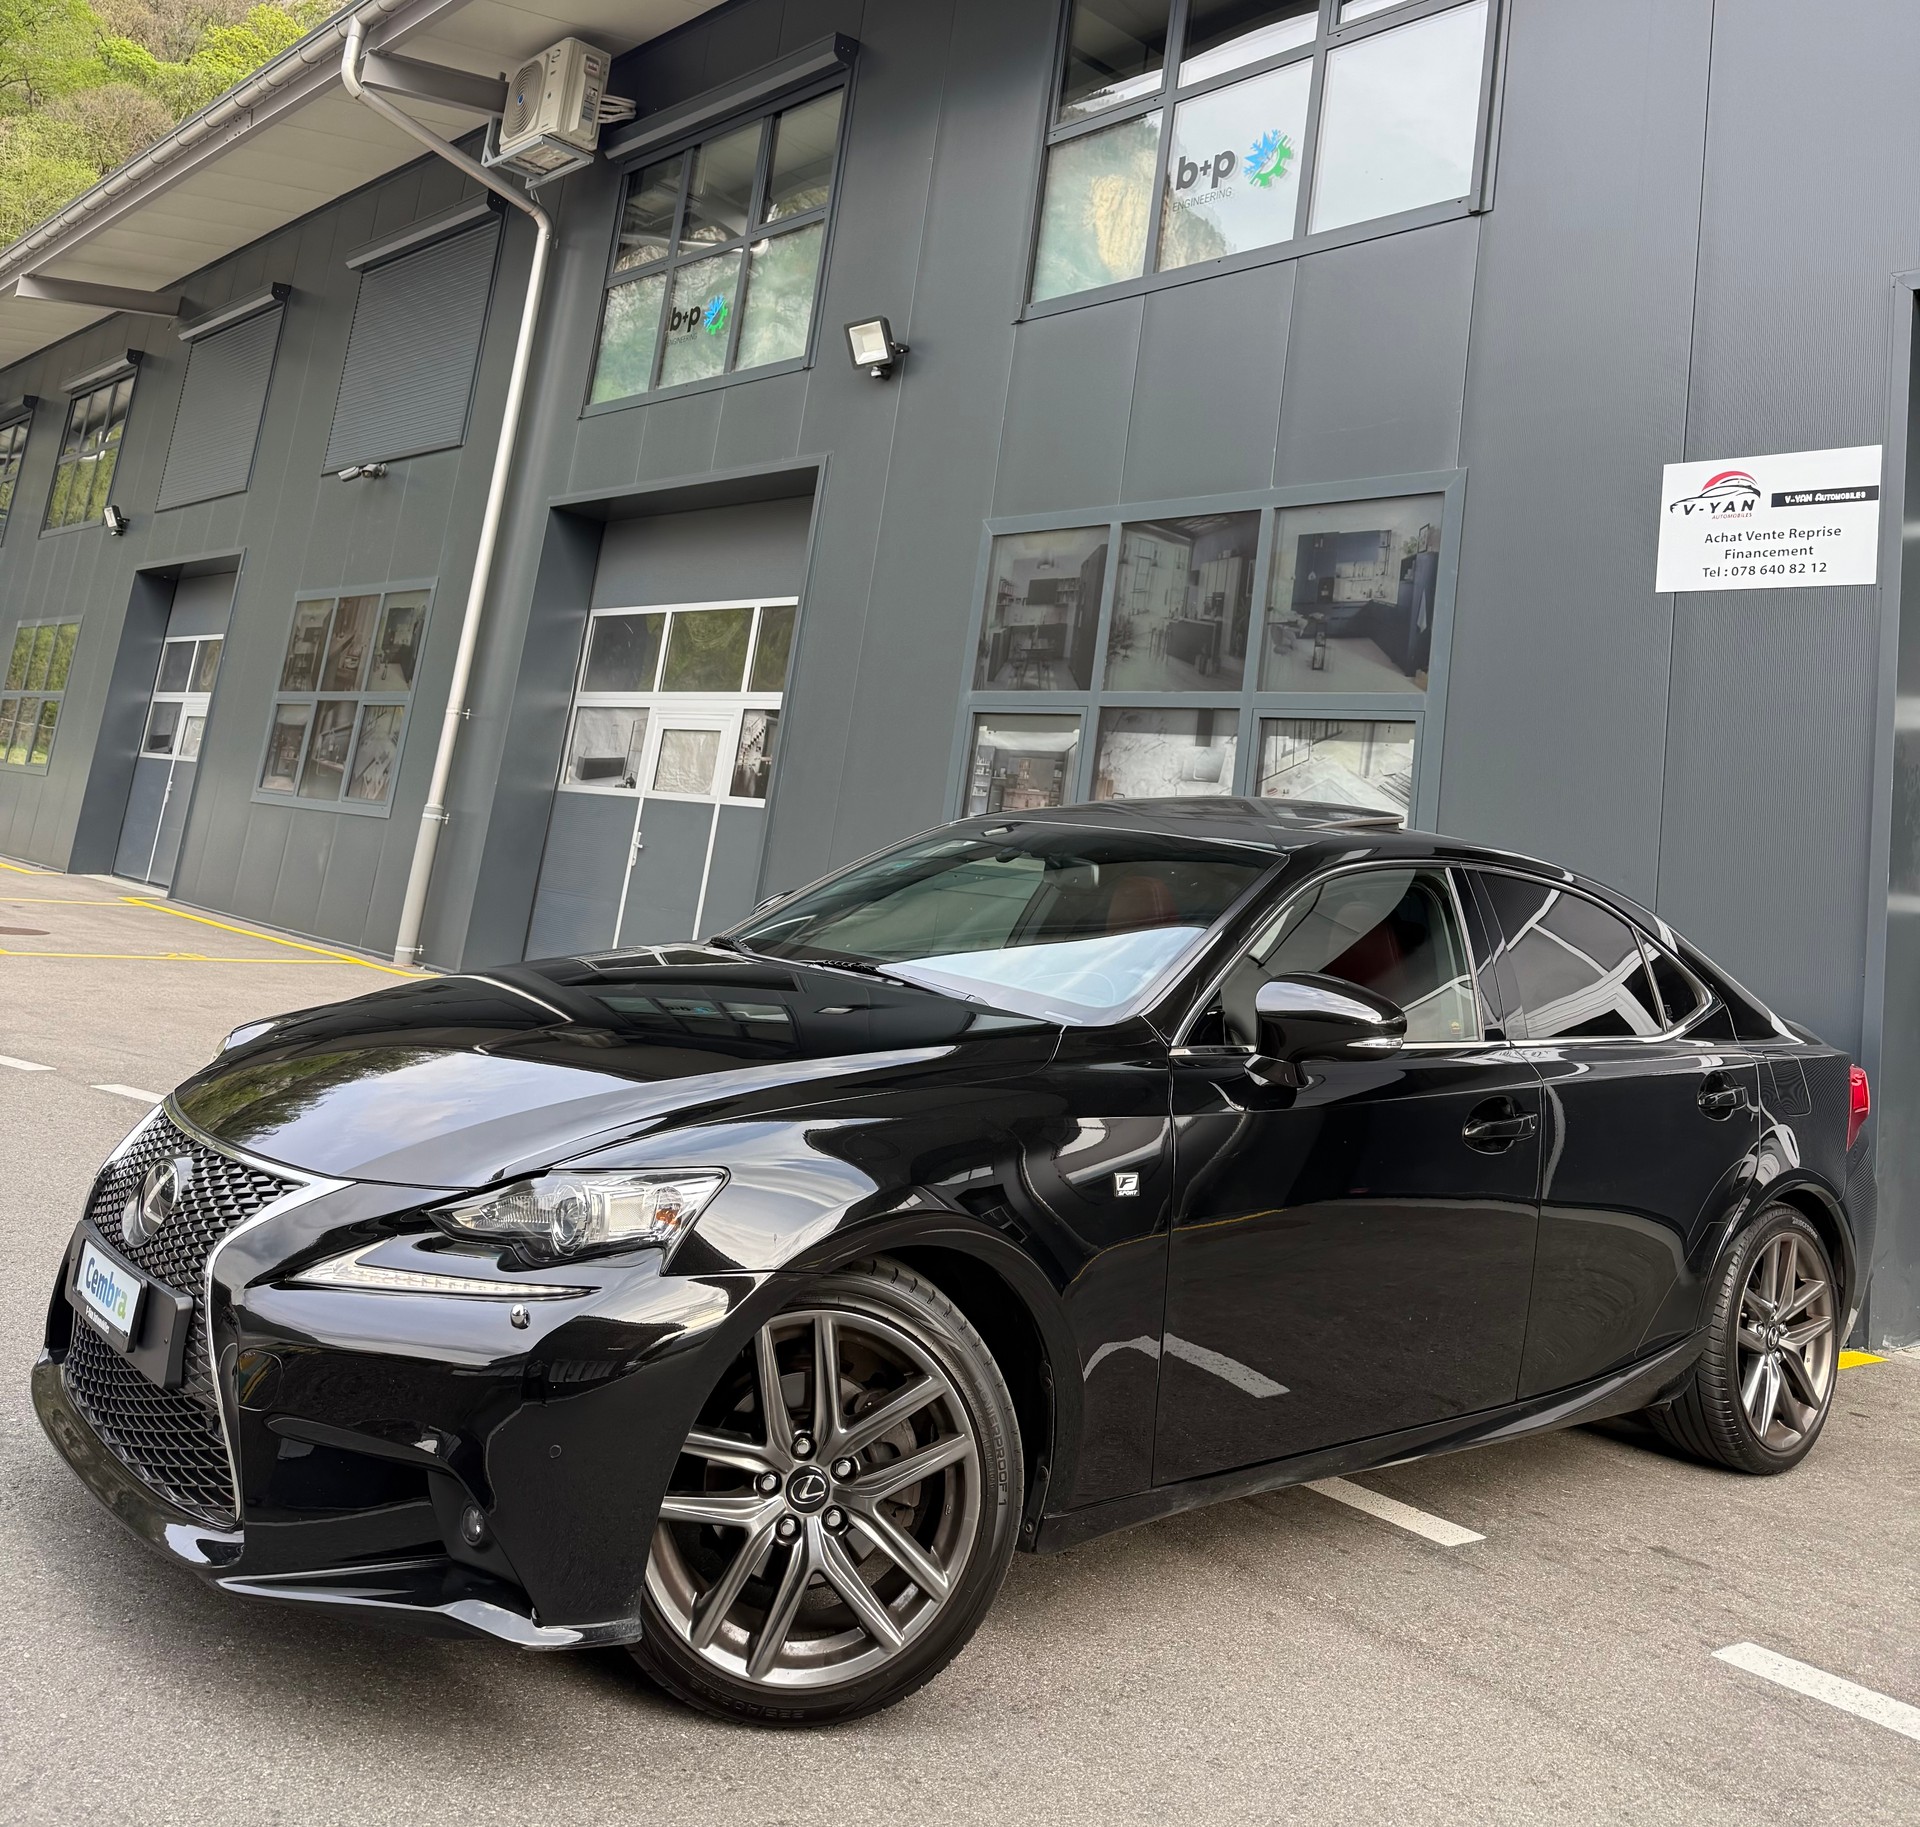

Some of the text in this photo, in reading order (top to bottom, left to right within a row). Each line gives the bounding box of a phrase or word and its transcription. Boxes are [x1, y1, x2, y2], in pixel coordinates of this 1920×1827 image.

[1176, 150, 1236, 191] b+p
[1172, 187, 1233, 213] ENGINEERING
[669, 305, 701, 333] b+p
[1683, 499, 1755, 516] V-YAN
[1784, 493, 1813, 504] V-YAN
[1712, 512, 1753, 520] AUTOMOBILES
[1704, 525, 1843, 544] Achat Vente Reprise
[1724, 545, 1815, 560] Financement
[1731, 565, 1756, 577] 078
[1759, 564, 1786, 576] 640
[1789, 562, 1806, 575] 82
[1811, 561, 1828, 574] 12
[85, 1256, 129, 1320] Cembra
[974, 1379, 1009, 1493] POWERPROOF
